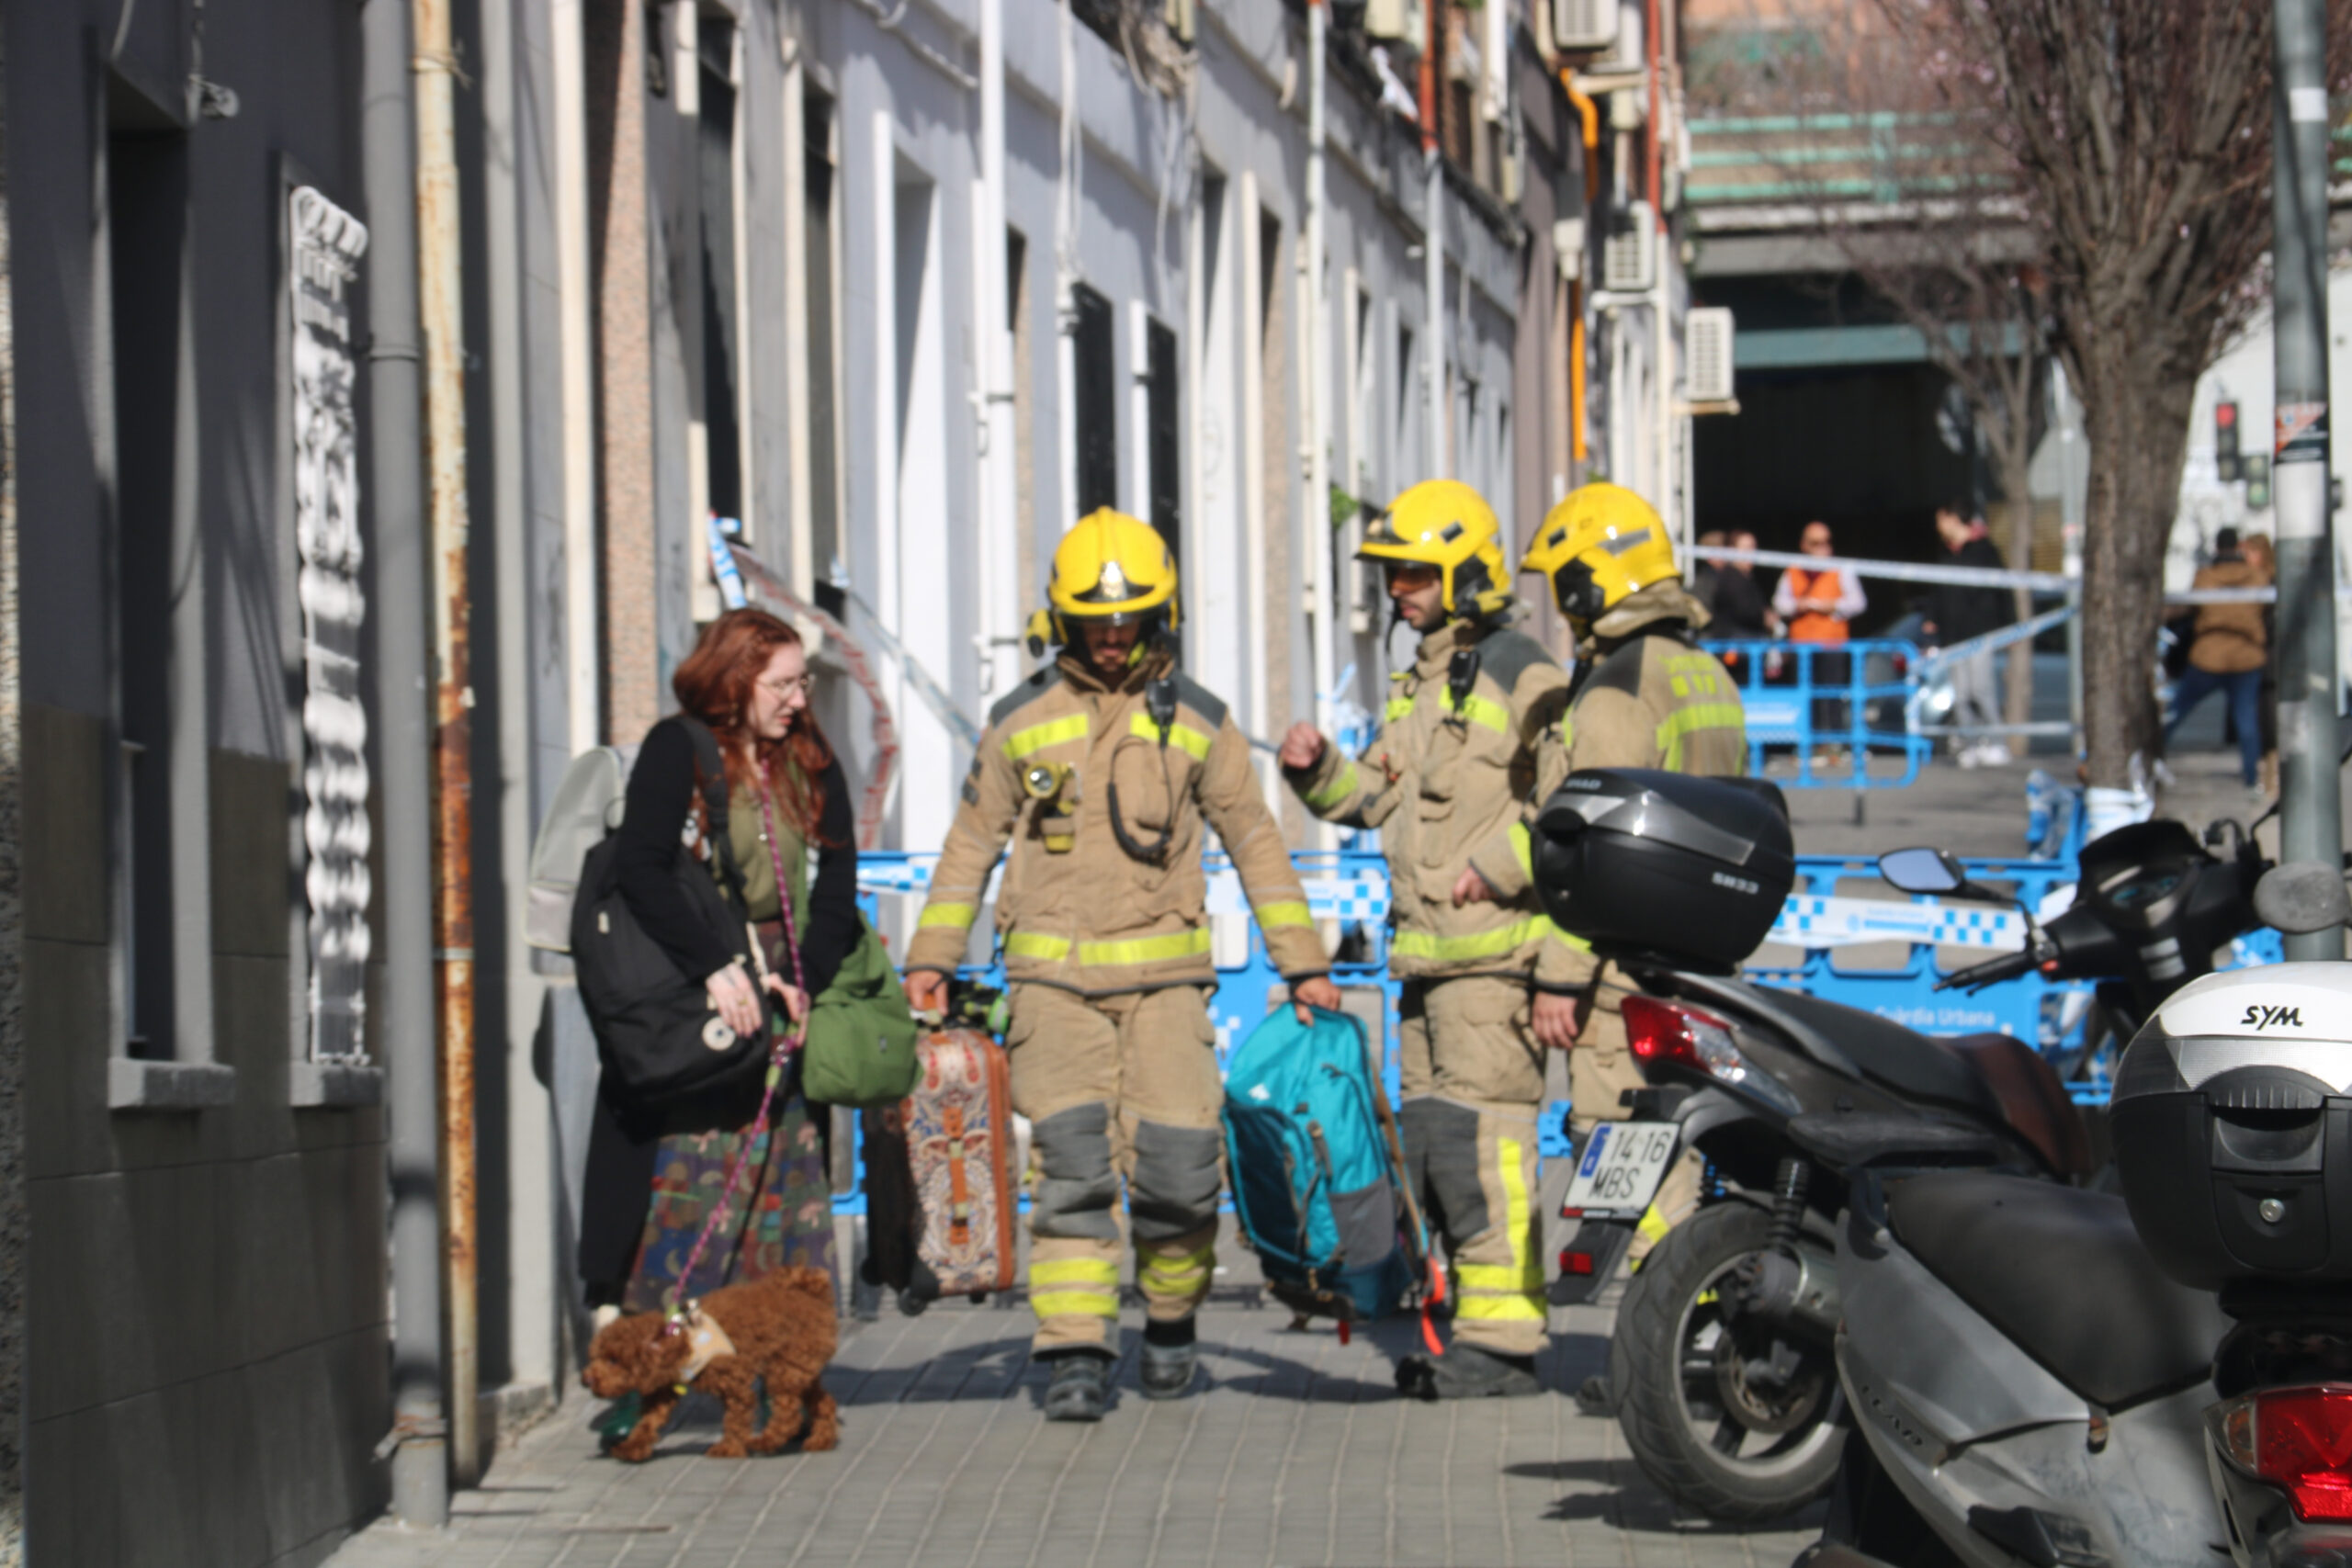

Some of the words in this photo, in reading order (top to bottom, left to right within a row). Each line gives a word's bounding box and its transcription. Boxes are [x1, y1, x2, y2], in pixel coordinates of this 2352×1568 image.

[2241, 1005, 2303, 1031] SYM
[1610, 1131, 1671, 1164] 1416
[1588, 1168, 1641, 1200] MBS
